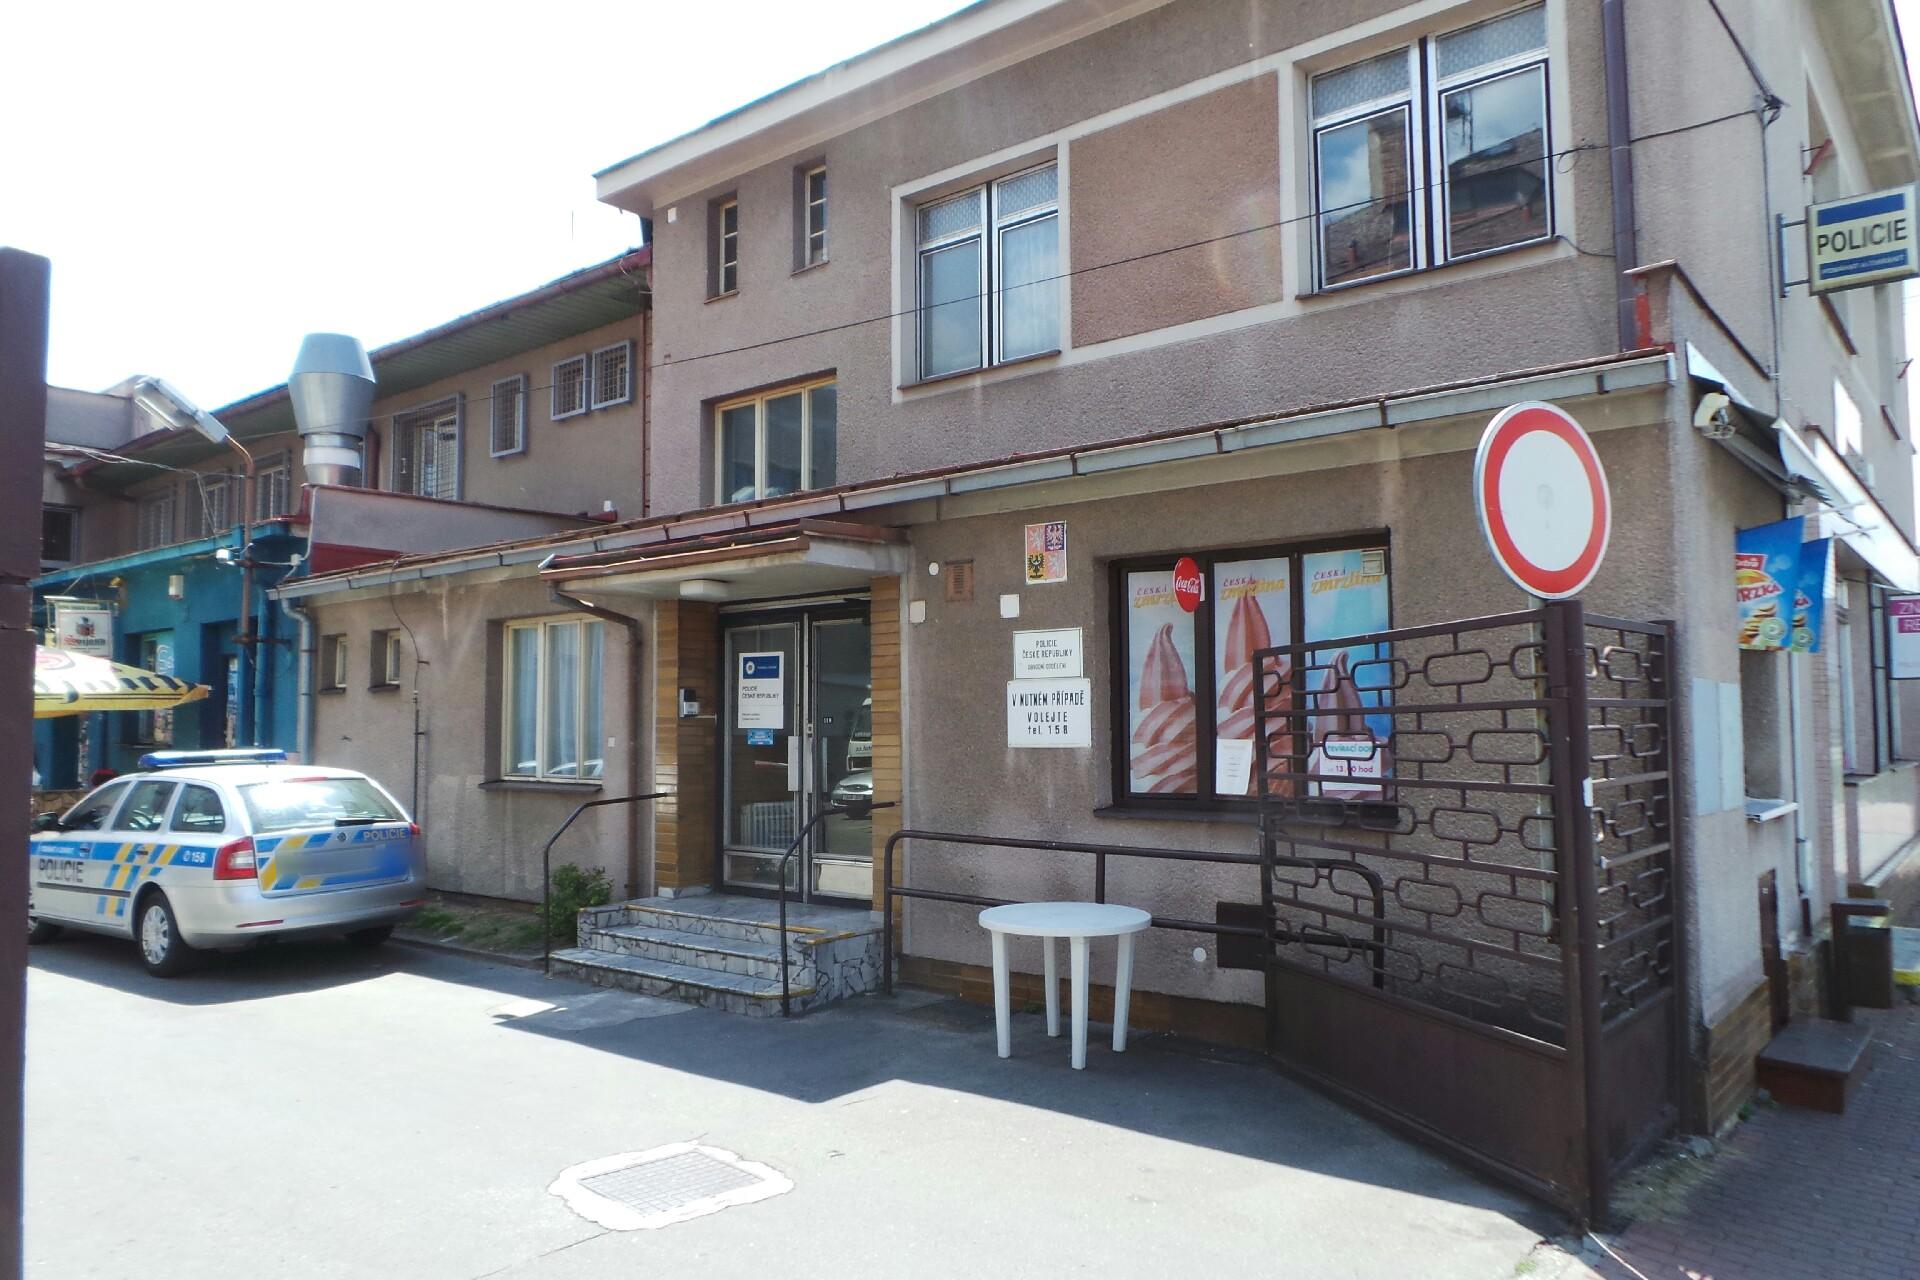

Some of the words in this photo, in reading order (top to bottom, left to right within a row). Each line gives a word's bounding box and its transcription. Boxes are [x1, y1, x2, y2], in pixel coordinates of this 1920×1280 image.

[1816, 218, 1908, 256] POLICIE
[1313, 566, 1346, 580] ČESKÁ
[1136, 583, 1167, 596] ČESKÁ
[1176, 575, 1200, 594] Coca-Cola
[1035, 640, 1057, 648] POLICIE
[1022, 650, 1040, 659] ČESKÉ
[1041, 649, 1073, 658] REPUBLIKY
[1012, 693, 1017, 706] V
[1019, 691, 1048, 706] NUTNÉM
[1051, 690, 1085, 706] PŘÍPADĚ
[1028, 711, 1068, 722] VOLEJTE
[1048, 724, 1068, 735] 158
[1358, 765, 1374, 773] hod
[363, 828, 407, 841] POLICIE
[191, 851, 206, 864] 158
[39, 858, 85, 883] POLICIE
